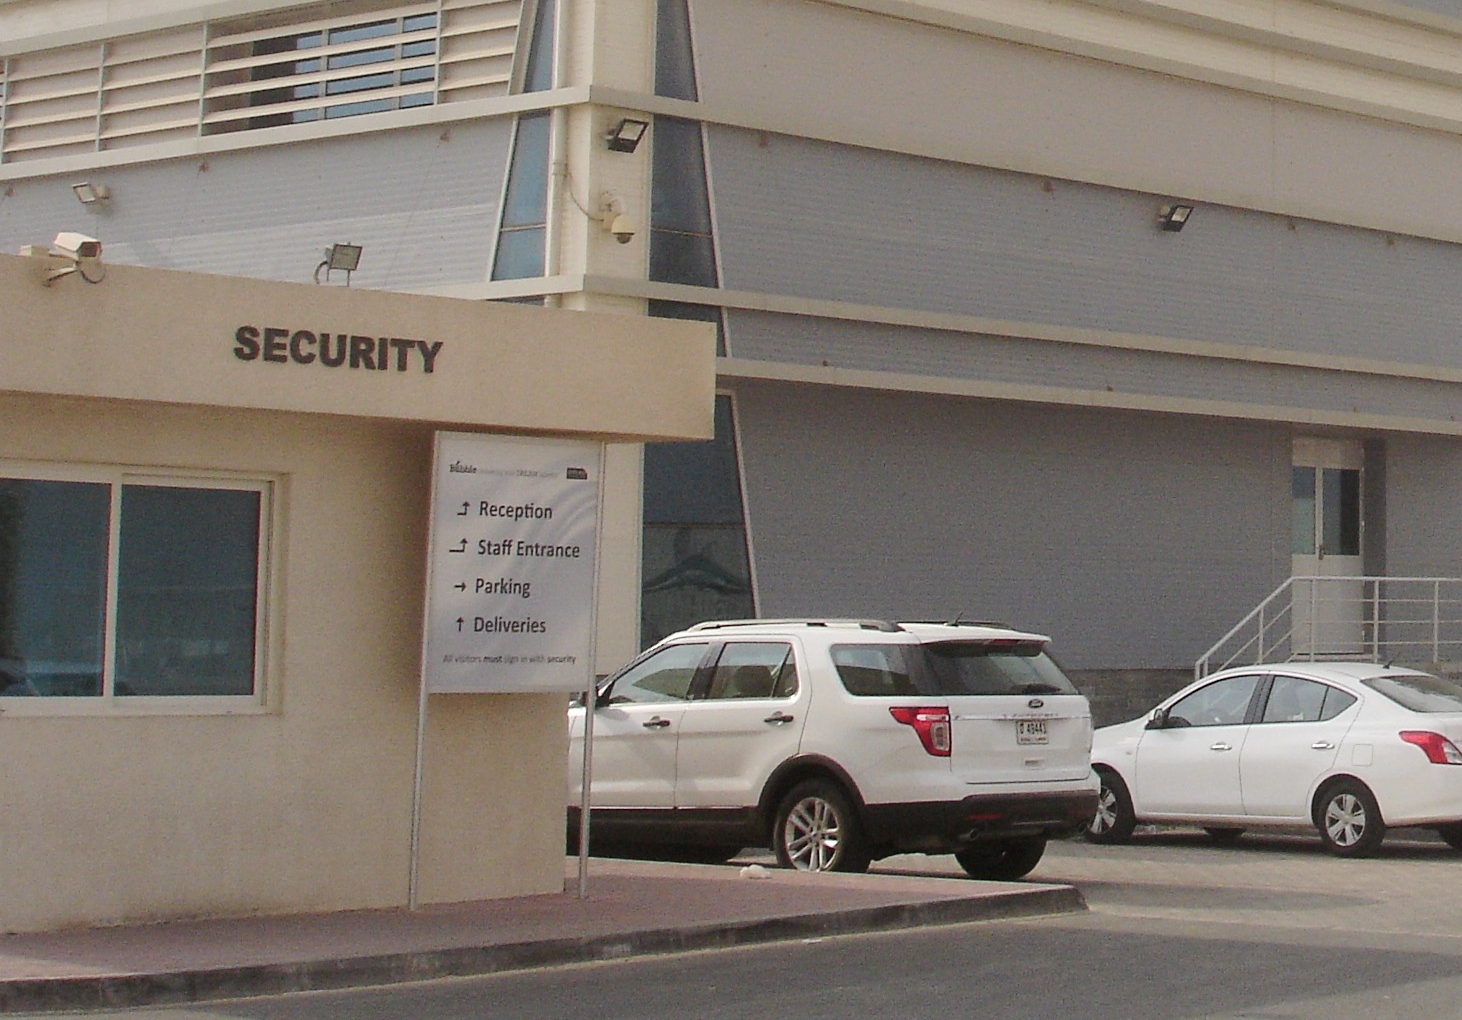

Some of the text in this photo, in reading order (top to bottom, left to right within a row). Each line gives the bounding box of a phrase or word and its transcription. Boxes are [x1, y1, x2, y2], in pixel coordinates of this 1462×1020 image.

[233, 325, 444, 373] SECURITY
[479, 500, 553, 521] Reception
[477, 538, 580, 558] Staff Entrance
[475, 577, 531, 599] Parking
[473, 616, 546, 634] Deliveries
[483, 654, 502, 664] must
[547, 655, 577, 666] security
